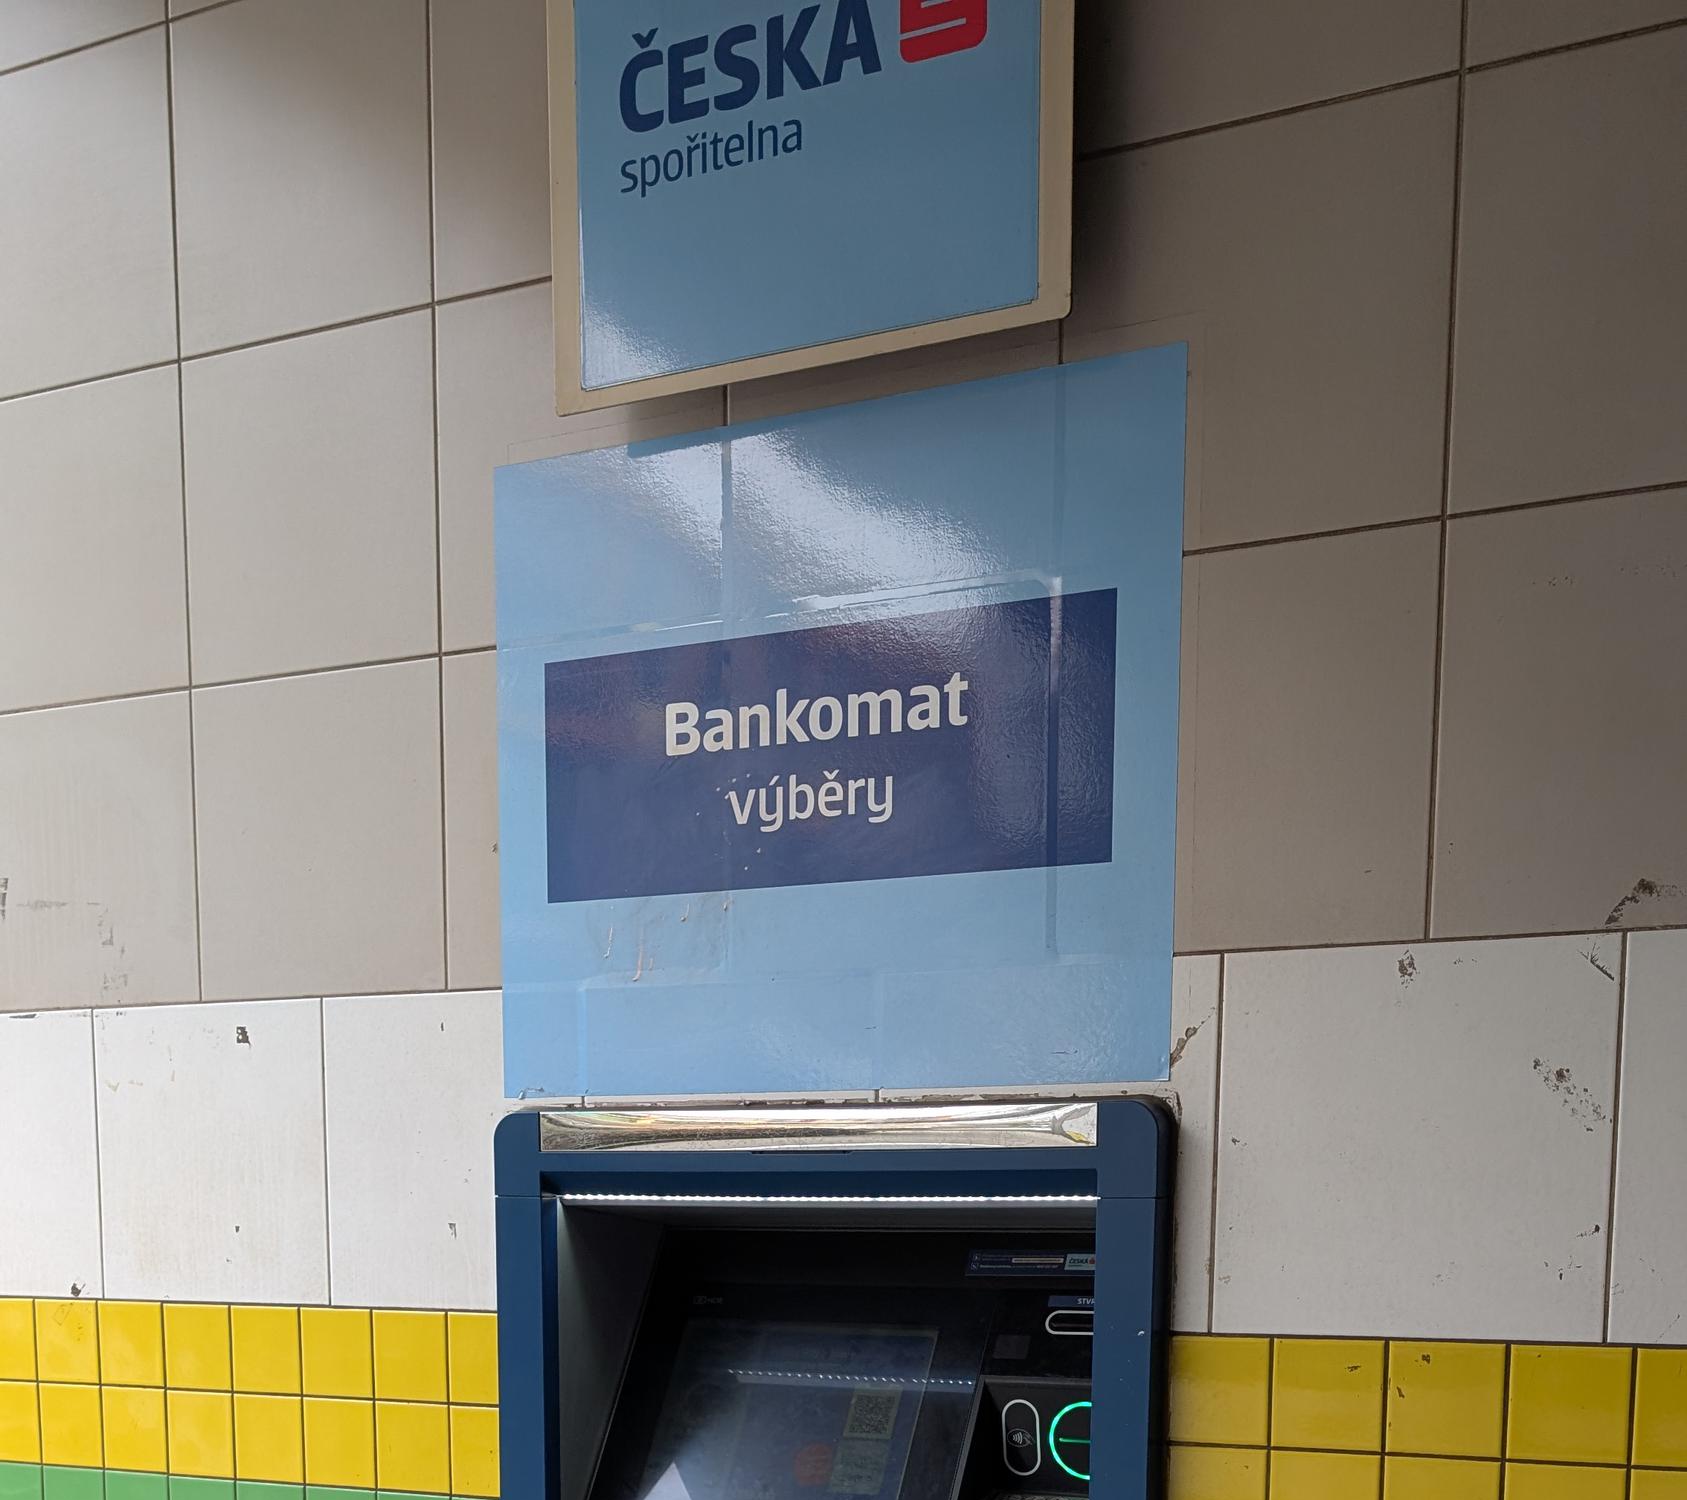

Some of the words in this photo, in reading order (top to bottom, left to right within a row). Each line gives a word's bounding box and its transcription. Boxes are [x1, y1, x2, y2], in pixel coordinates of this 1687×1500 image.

[620, 119, 802, 198] spořitelna
[665, 672, 969, 757] Bankomat
[728, 770, 894, 833] výběry
